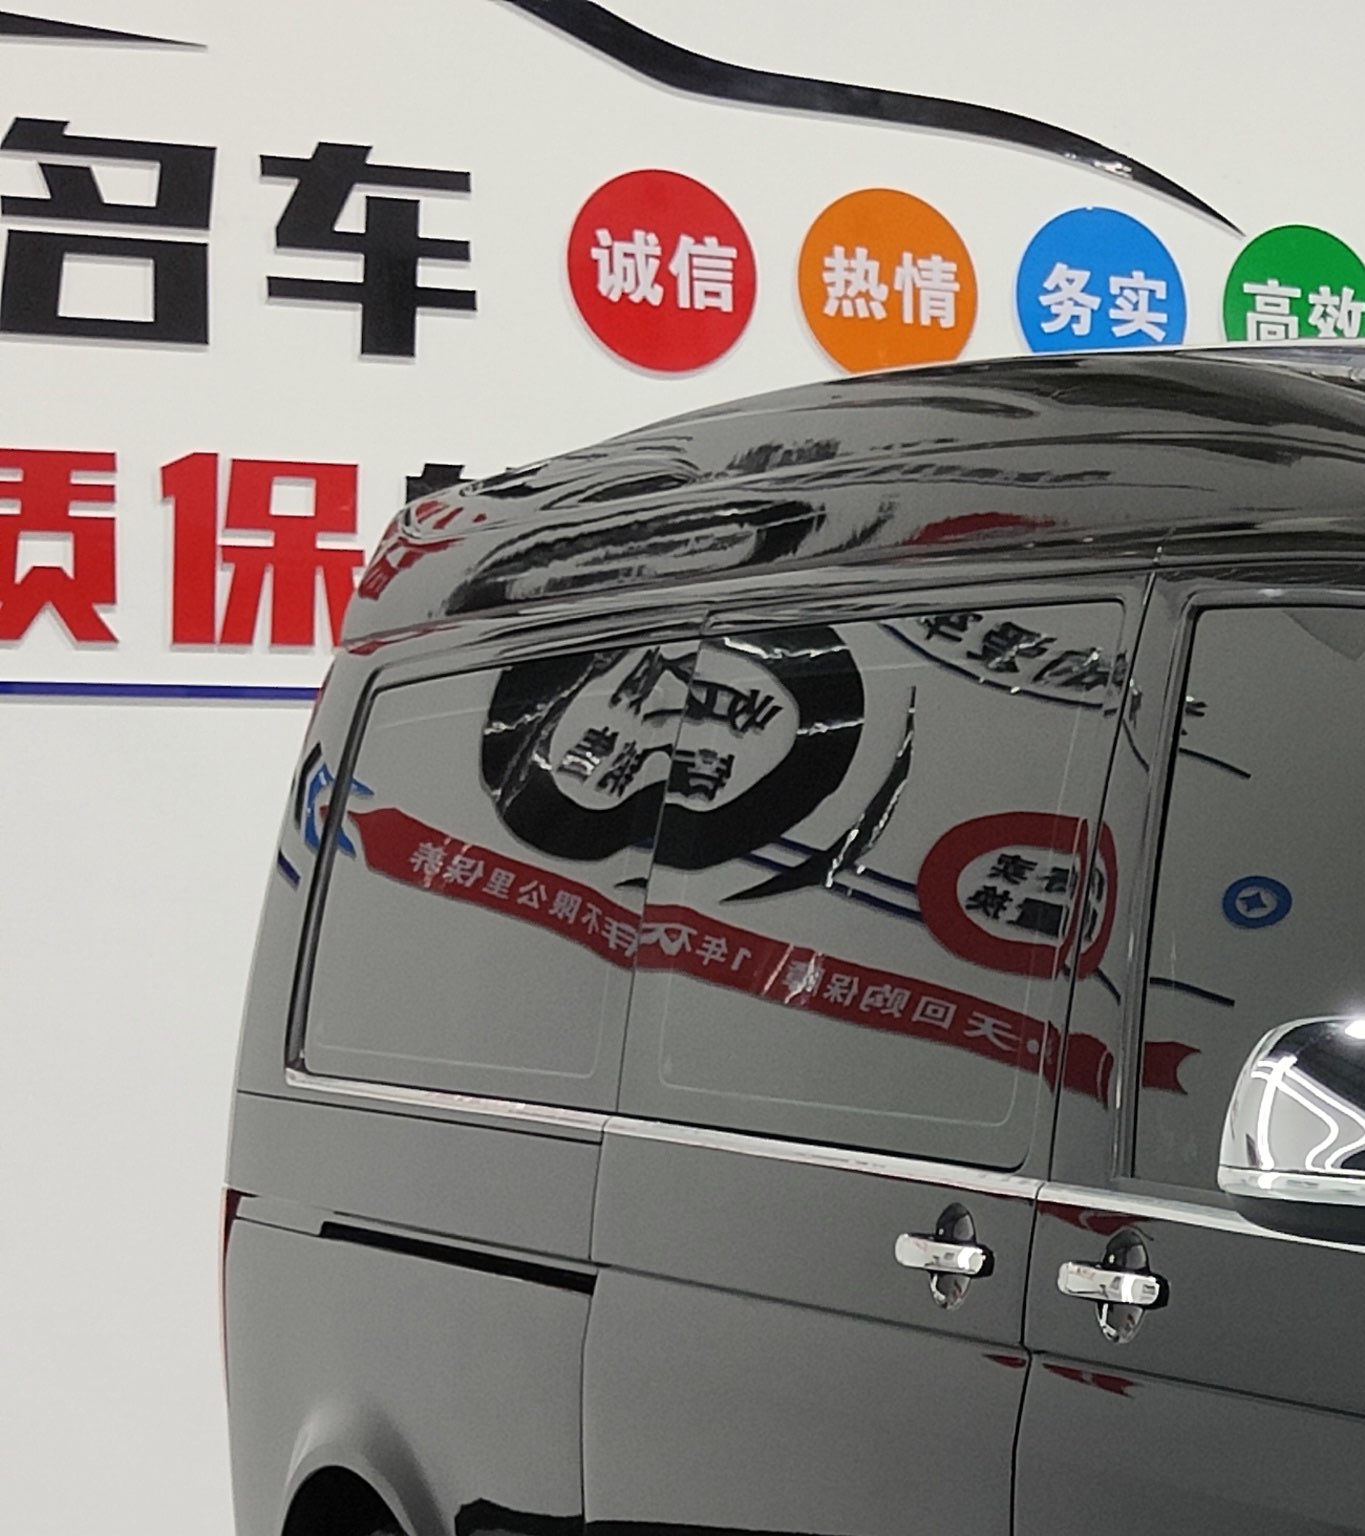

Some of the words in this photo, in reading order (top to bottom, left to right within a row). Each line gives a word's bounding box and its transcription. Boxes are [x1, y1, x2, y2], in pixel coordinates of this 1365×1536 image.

[0, 116, 478, 359] 名车
[590, 228, 738, 313] 诚信
[821, 244, 961, 329] 热情
[1038, 261, 1169, 342] 务实
